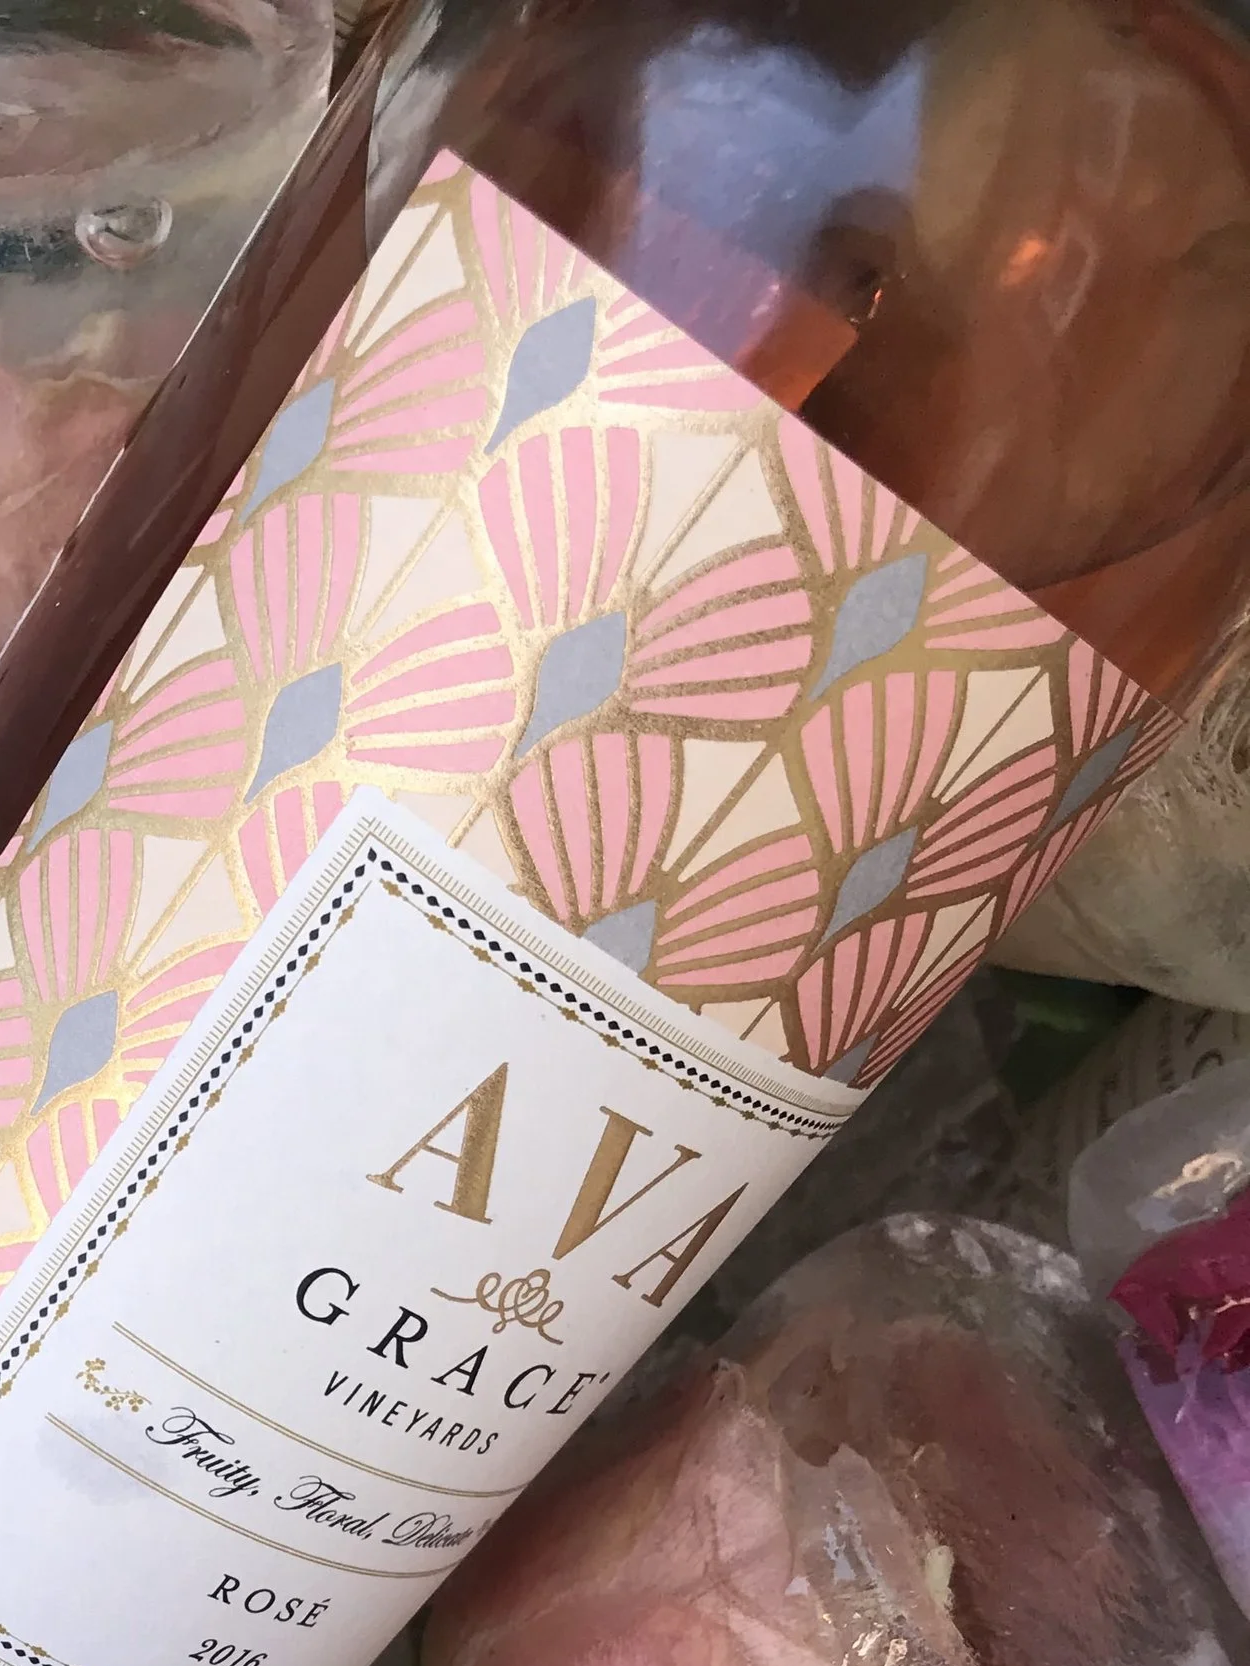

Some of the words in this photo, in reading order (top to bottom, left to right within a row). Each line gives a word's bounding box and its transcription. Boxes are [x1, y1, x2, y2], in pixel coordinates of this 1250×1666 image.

[365, 1062, 749, 1308] AVA
[324, 1370, 499, 1455] VINEYARDS
[145, 1406, 261, 1498] Fruity,
[273, 1474, 391, 1541] Floral,
[206, 1573, 332, 1628] ROSÉ
